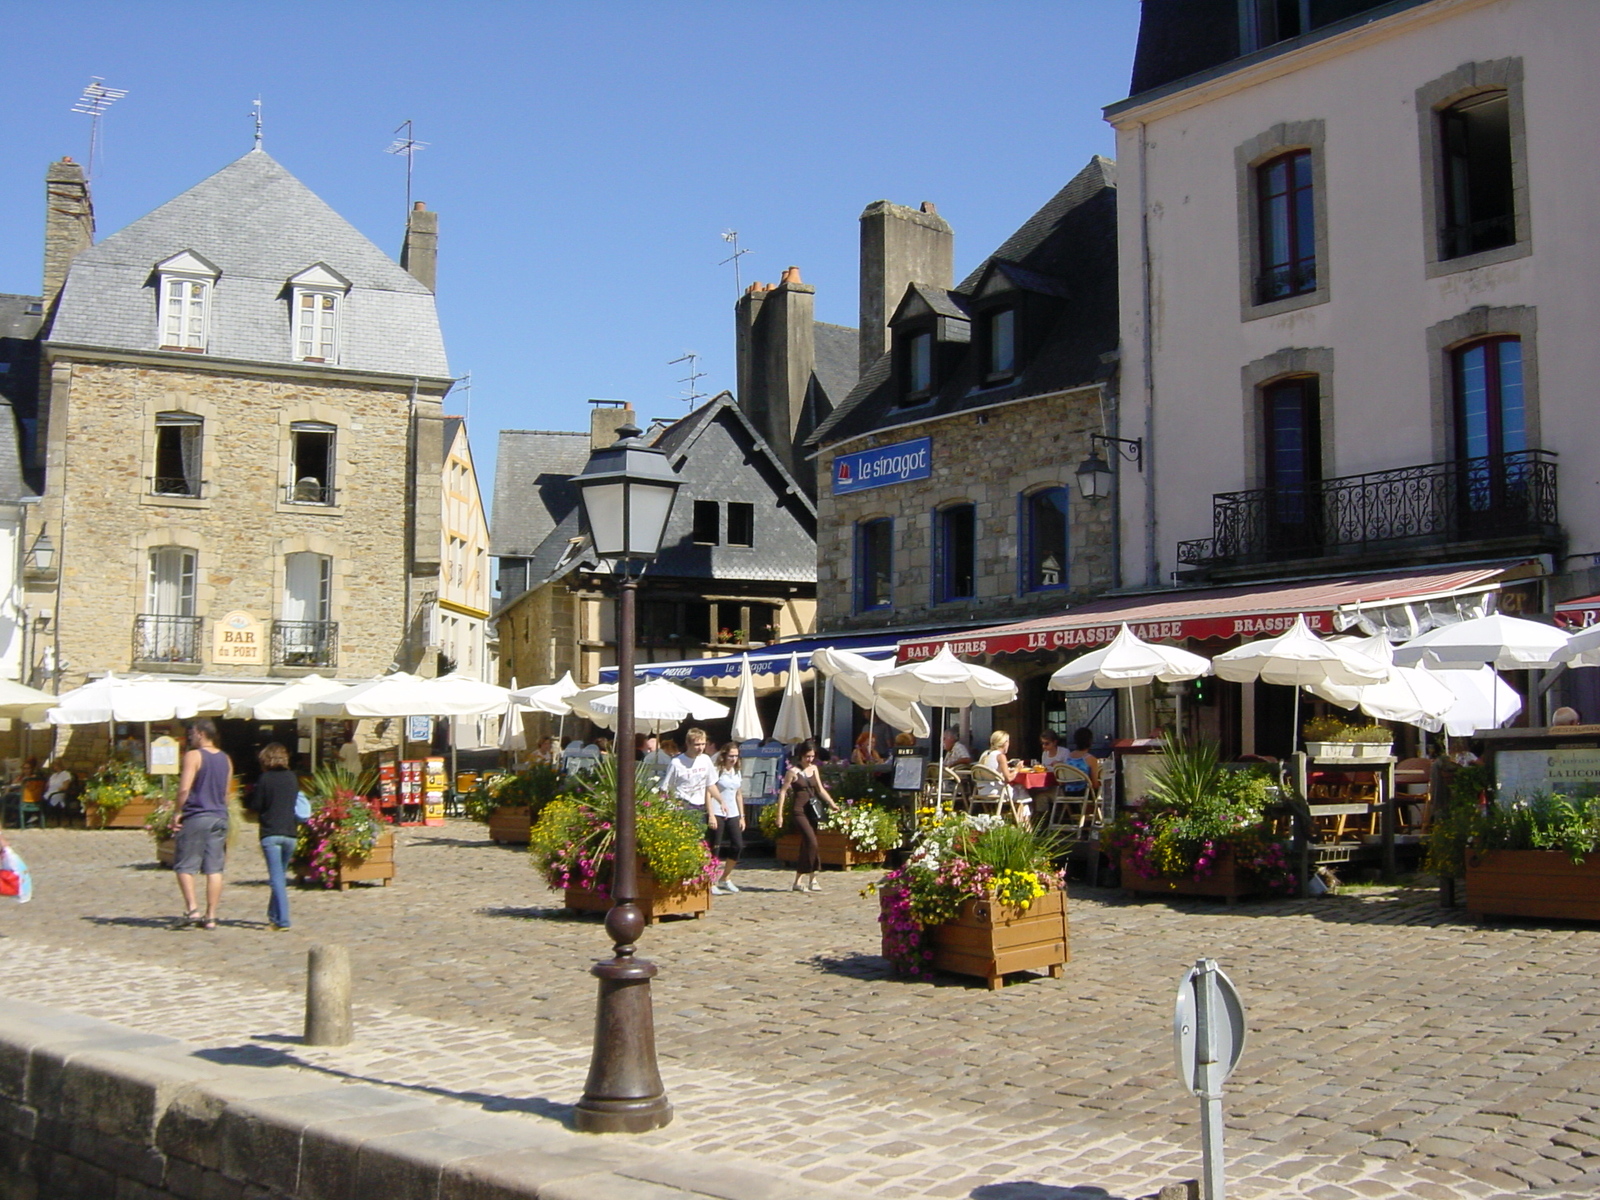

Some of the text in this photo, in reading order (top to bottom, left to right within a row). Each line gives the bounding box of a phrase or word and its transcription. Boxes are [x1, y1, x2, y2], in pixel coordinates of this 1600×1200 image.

[858, 448, 926, 480] le sinagot
[224, 631, 255, 643] BAR
[1028, 633, 1047, 647] LE
[1053, 627, 1116, 645] CHASSE
[219, 646, 257, 657] du PORT
[907, 645, 930, 658] BAR
[1548, 770, 1562, 778] LA
